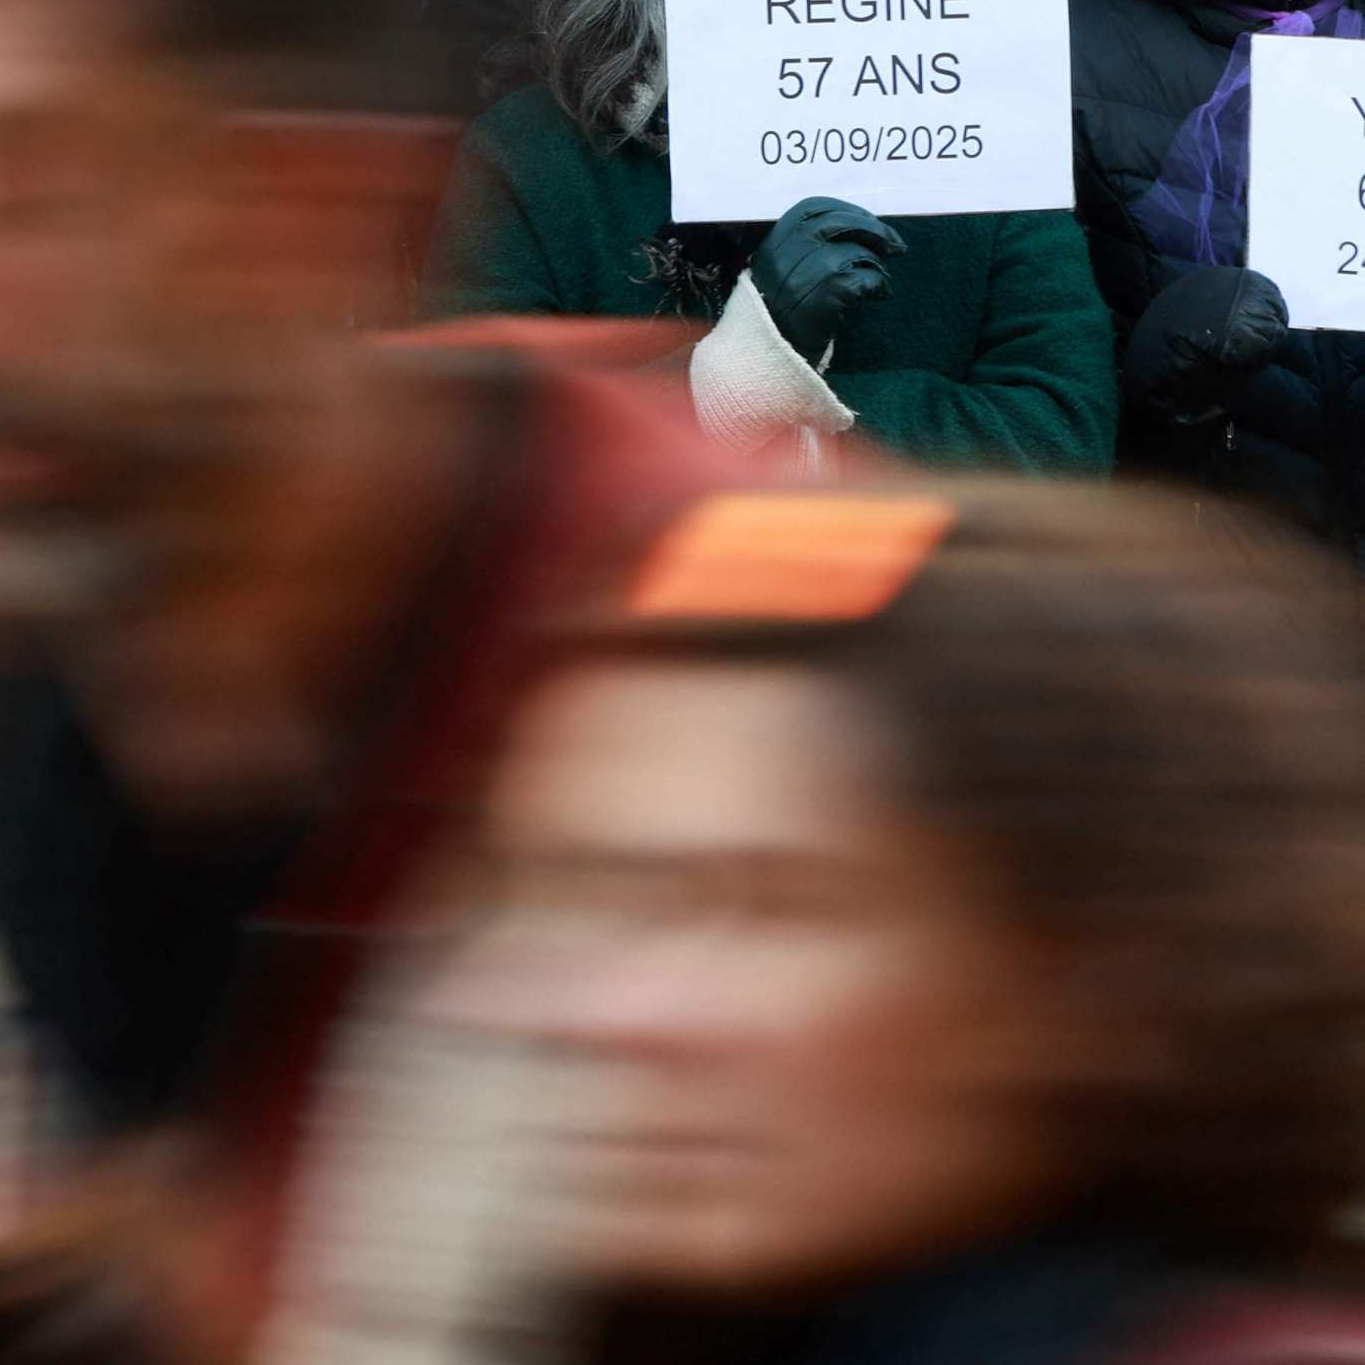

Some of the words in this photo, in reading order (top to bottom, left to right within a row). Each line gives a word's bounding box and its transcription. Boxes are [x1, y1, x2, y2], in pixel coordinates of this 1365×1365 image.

[778, 57, 834, 99] 57
[852, 52, 961, 97] ANS
[760, 124, 983, 165] 03/09/2025
[1337, 241, 1365, 276] 2
